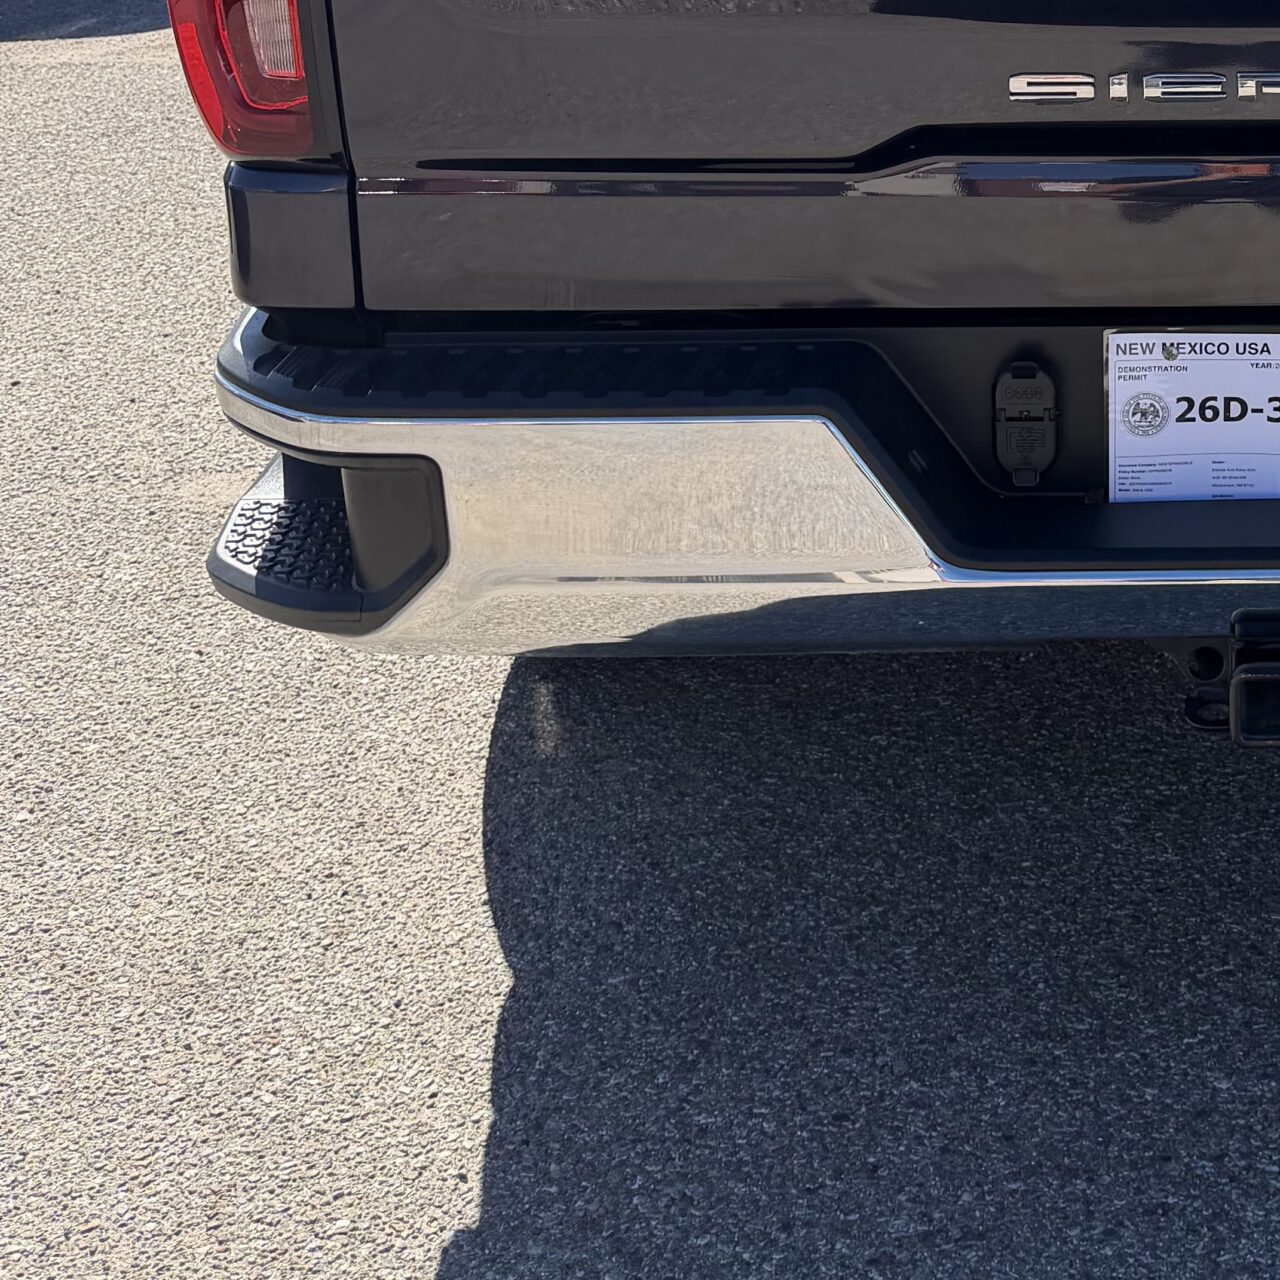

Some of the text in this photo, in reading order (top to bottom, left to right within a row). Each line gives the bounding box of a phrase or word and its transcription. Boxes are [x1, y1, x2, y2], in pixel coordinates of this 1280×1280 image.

[1115, 342, 1156, 356] NEW
[1235, 342, 1272, 356] USA
[1117, 365, 1189, 374] DEMONSTRATION
[1117, 374, 1148, 382] PERMIT
